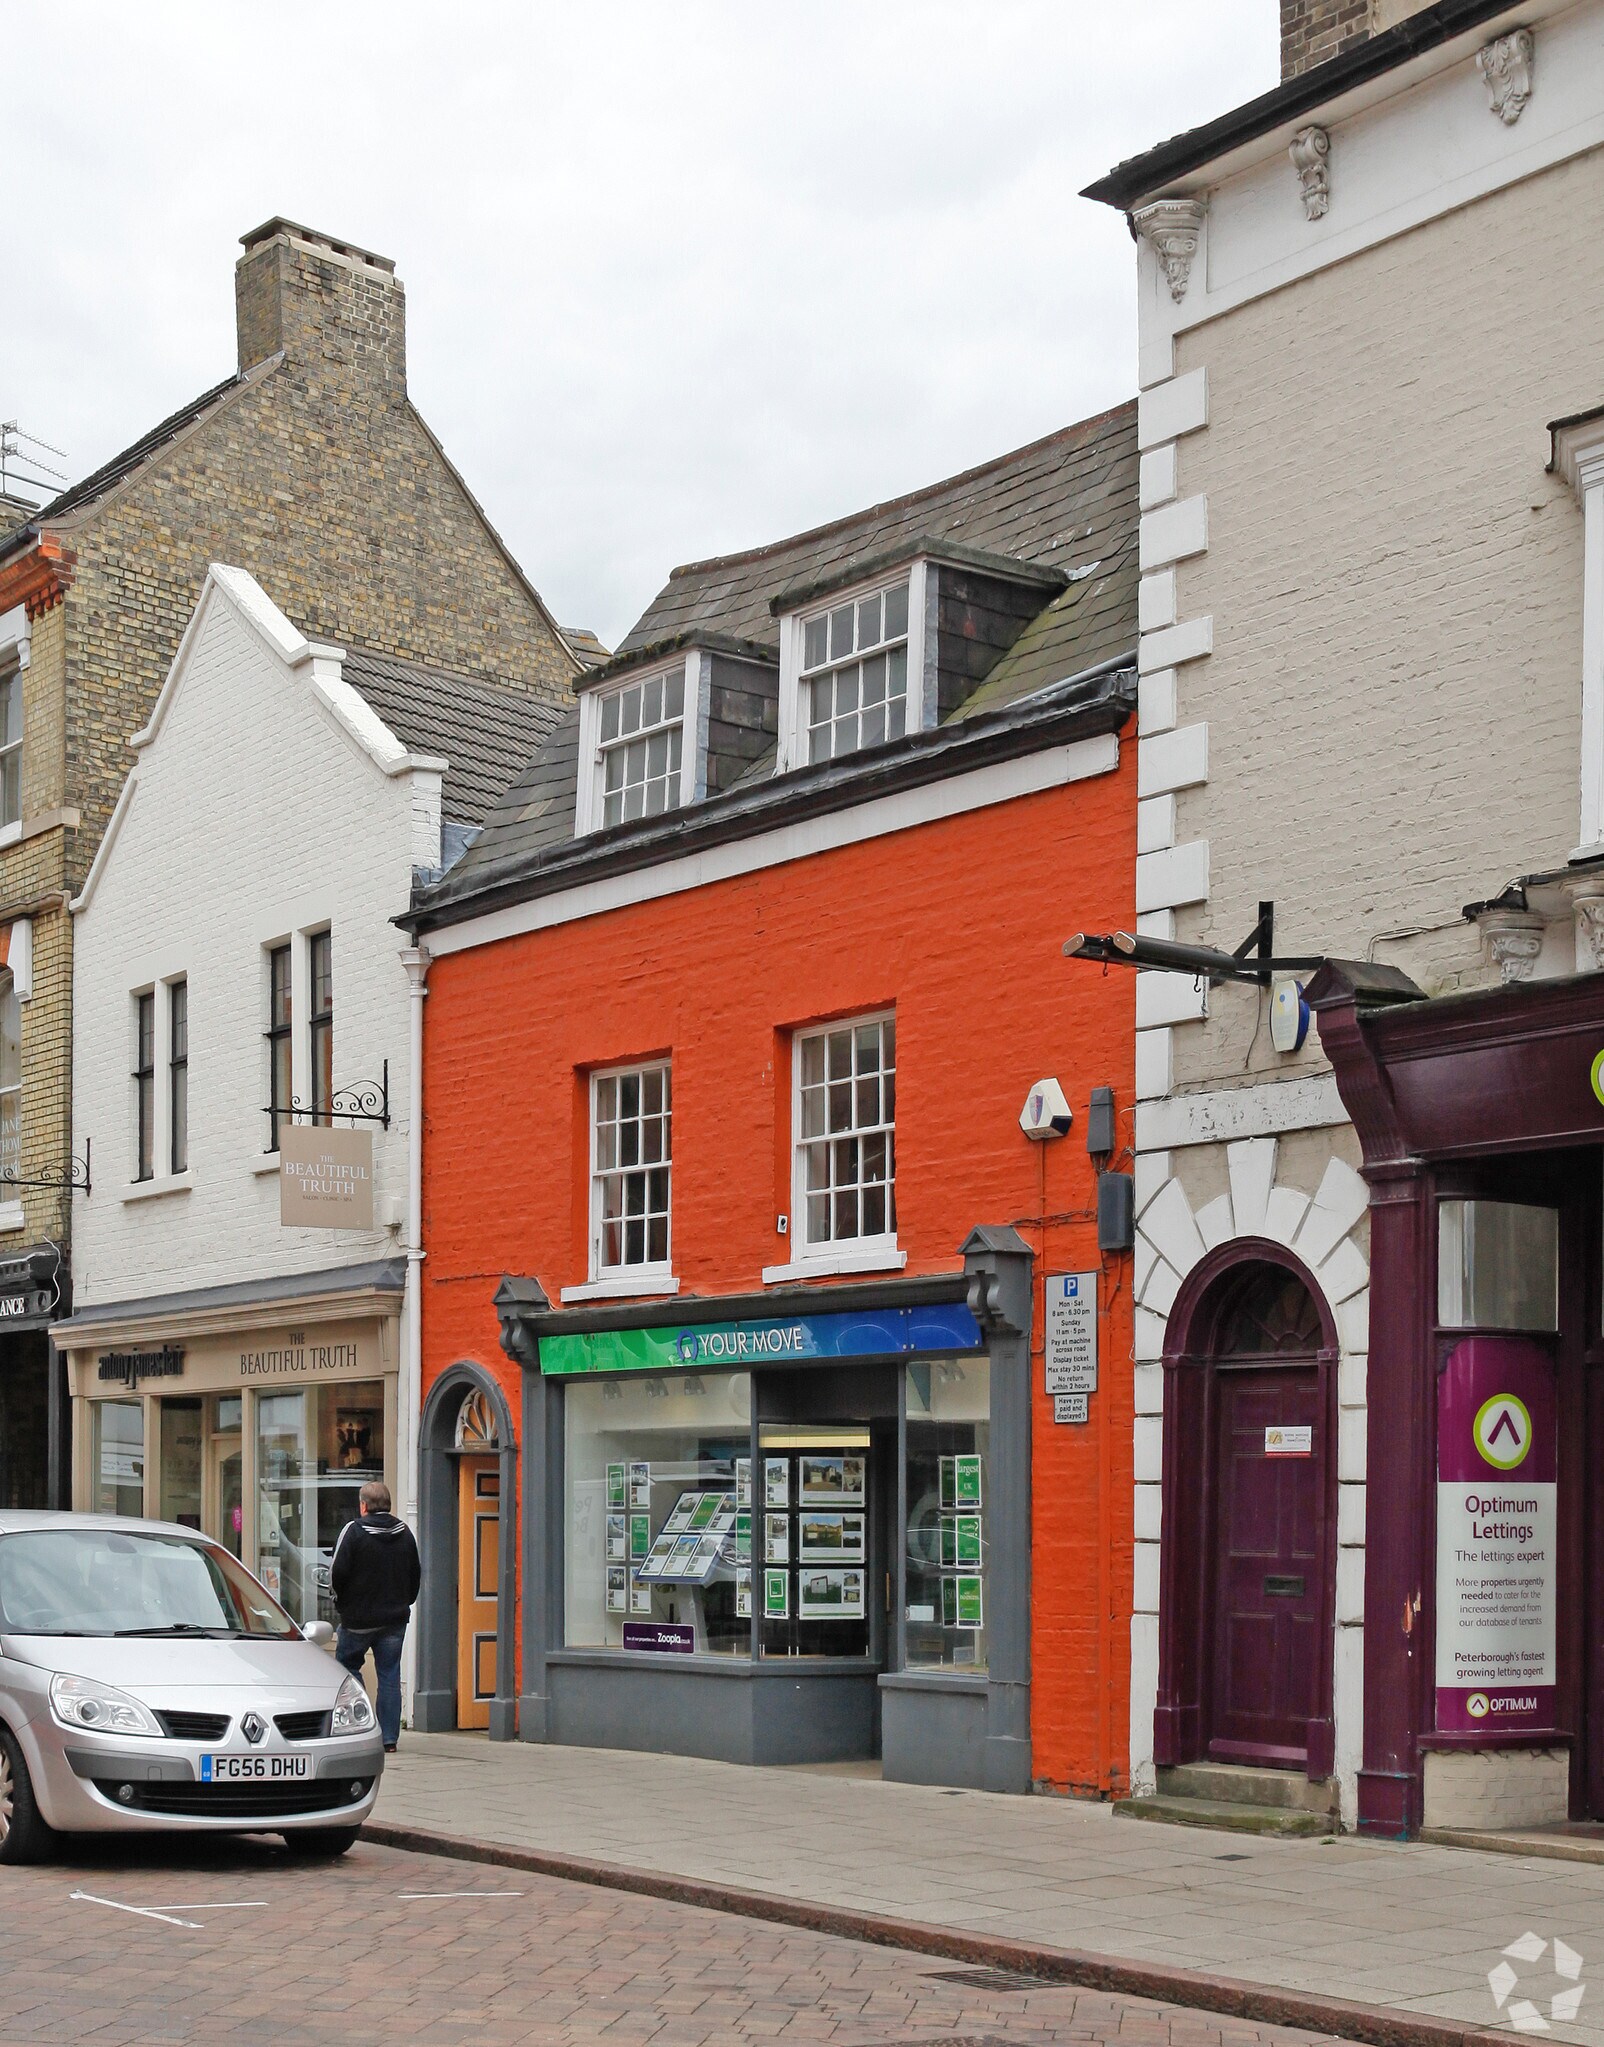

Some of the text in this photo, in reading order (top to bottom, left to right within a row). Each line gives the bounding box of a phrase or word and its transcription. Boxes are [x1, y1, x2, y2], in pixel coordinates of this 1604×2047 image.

[320, 1155, 334, 1163] THE
[285, 1161, 370, 1180] BEAUTIFUL
[299, 1178, 355, 1195] TRUTH
[1068, 1308, 1081, 1316] 6.30
[1061, 1319, 1081, 1327] Sunday
[289, 1332, 306, 1346] THE
[700, 1327, 804, 1357] YOUR MOVE
[1069, 1337, 1091, 1345] machine
[240, 1343, 358, 1376] BEAUTIFUL TRUTH
[1053, 1356, 1072, 1364] Display
[1060, 1366, 1071, 1374] stay
[957, 1462, 979, 1477] largest
[963, 1482, 973, 1491] UK
[1465, 1495, 1538, 1518] Optimum
[1473, 1521, 1534, 1544] Lettings
[1455, 1550, 1545, 1565] The lettings expert
[1455, 1576, 1545, 1588] More properties urgently
[1461, 1589, 1541, 1600] needed to cater for the
[1459, 1603, 1542, 1614] increased demand from
[1476, 1618, 1510, 1627] database
[1510, 1616, 1518, 1626] of
[1518, 1616, 1543, 1625] tenants
[1454, 1650, 1546, 1664] Peterborough's fastest
[1456, 1667, 1544, 1680] growing letting agent
[1489, 1697, 1538, 1712] OPTIMUM
[215, 1757, 306, 1778] FG56 DHU
